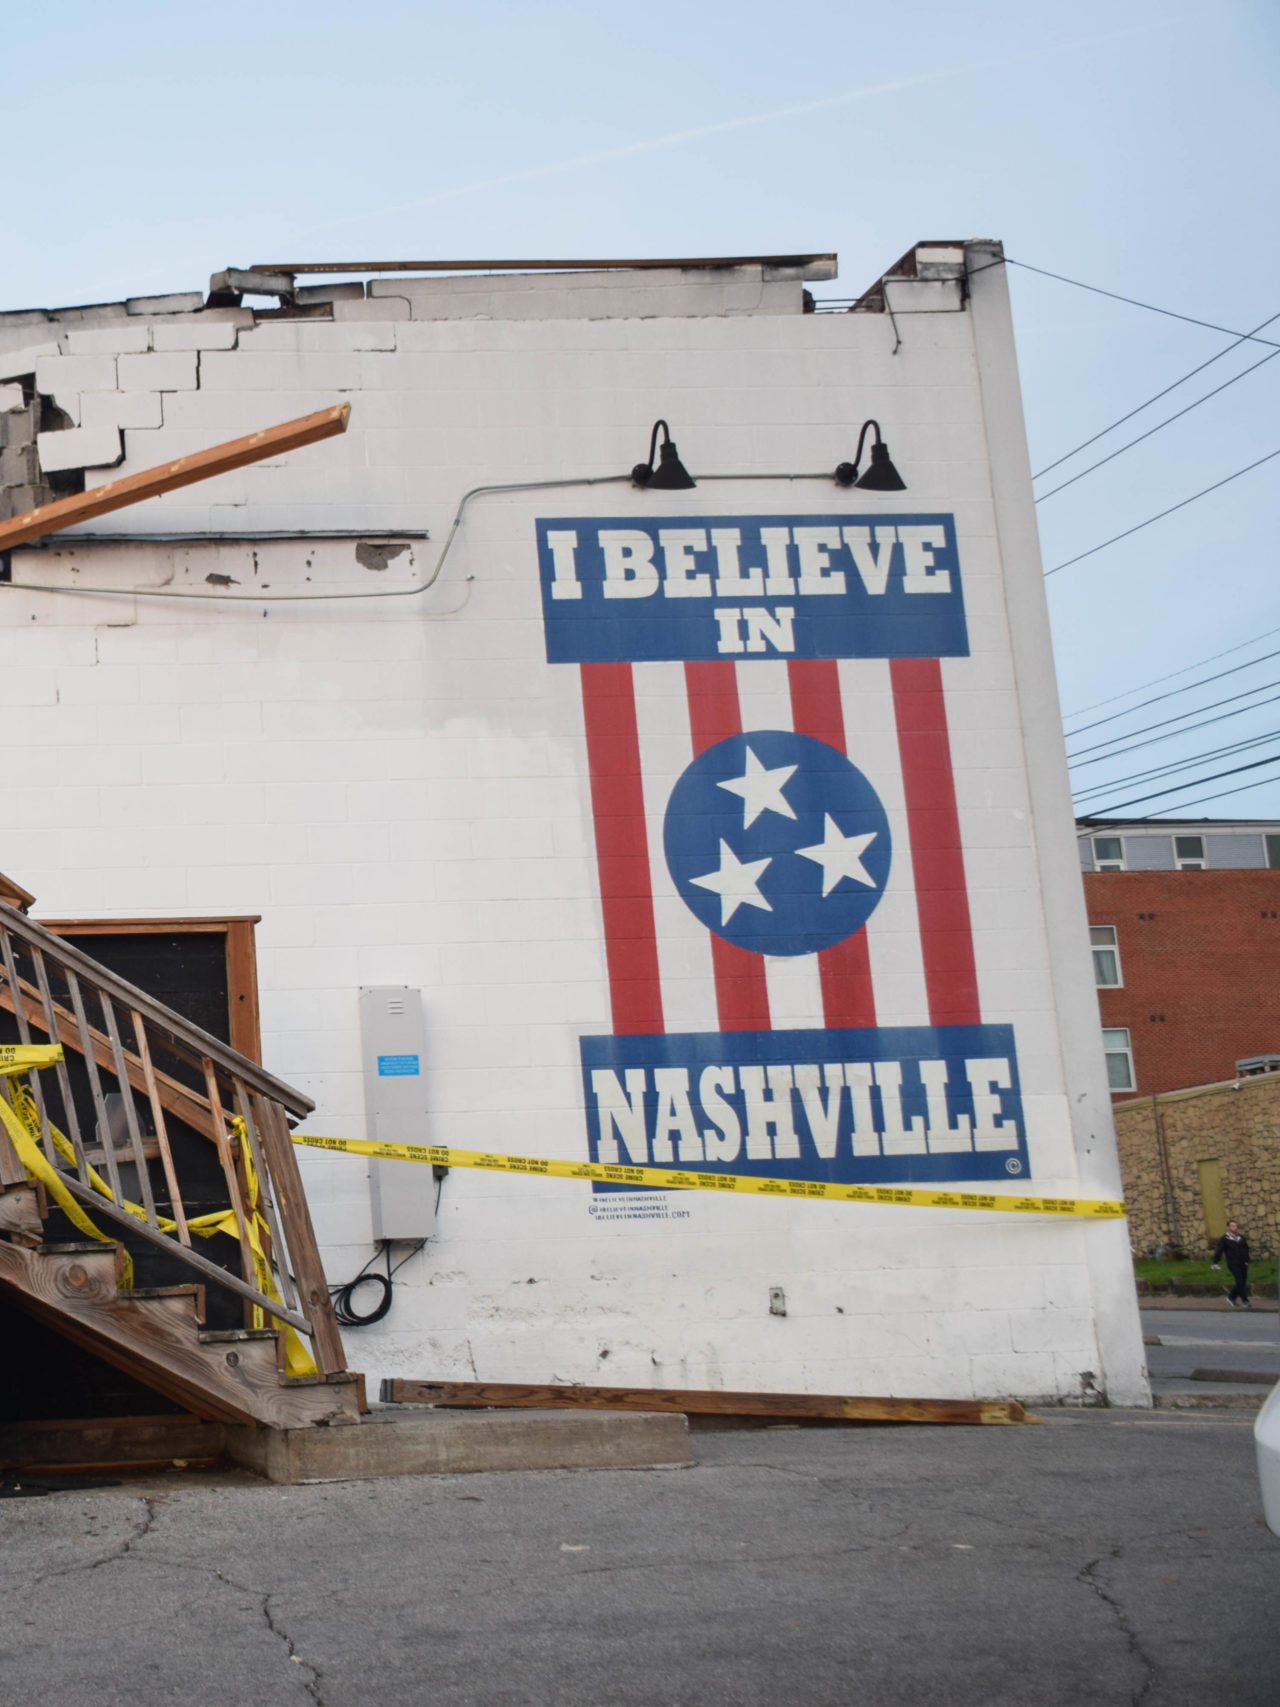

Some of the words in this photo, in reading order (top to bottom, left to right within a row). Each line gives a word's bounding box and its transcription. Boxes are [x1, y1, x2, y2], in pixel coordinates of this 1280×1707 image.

[547, 530, 582, 600] I
[597, 525, 952, 600] BELIEVE
[714, 606, 796, 653] IN
[591, 1058, 1019, 1163] NASHVILLE
[407, 1146, 426, 1154] CROSS
[529, 1165, 547, 1173] CRIME
